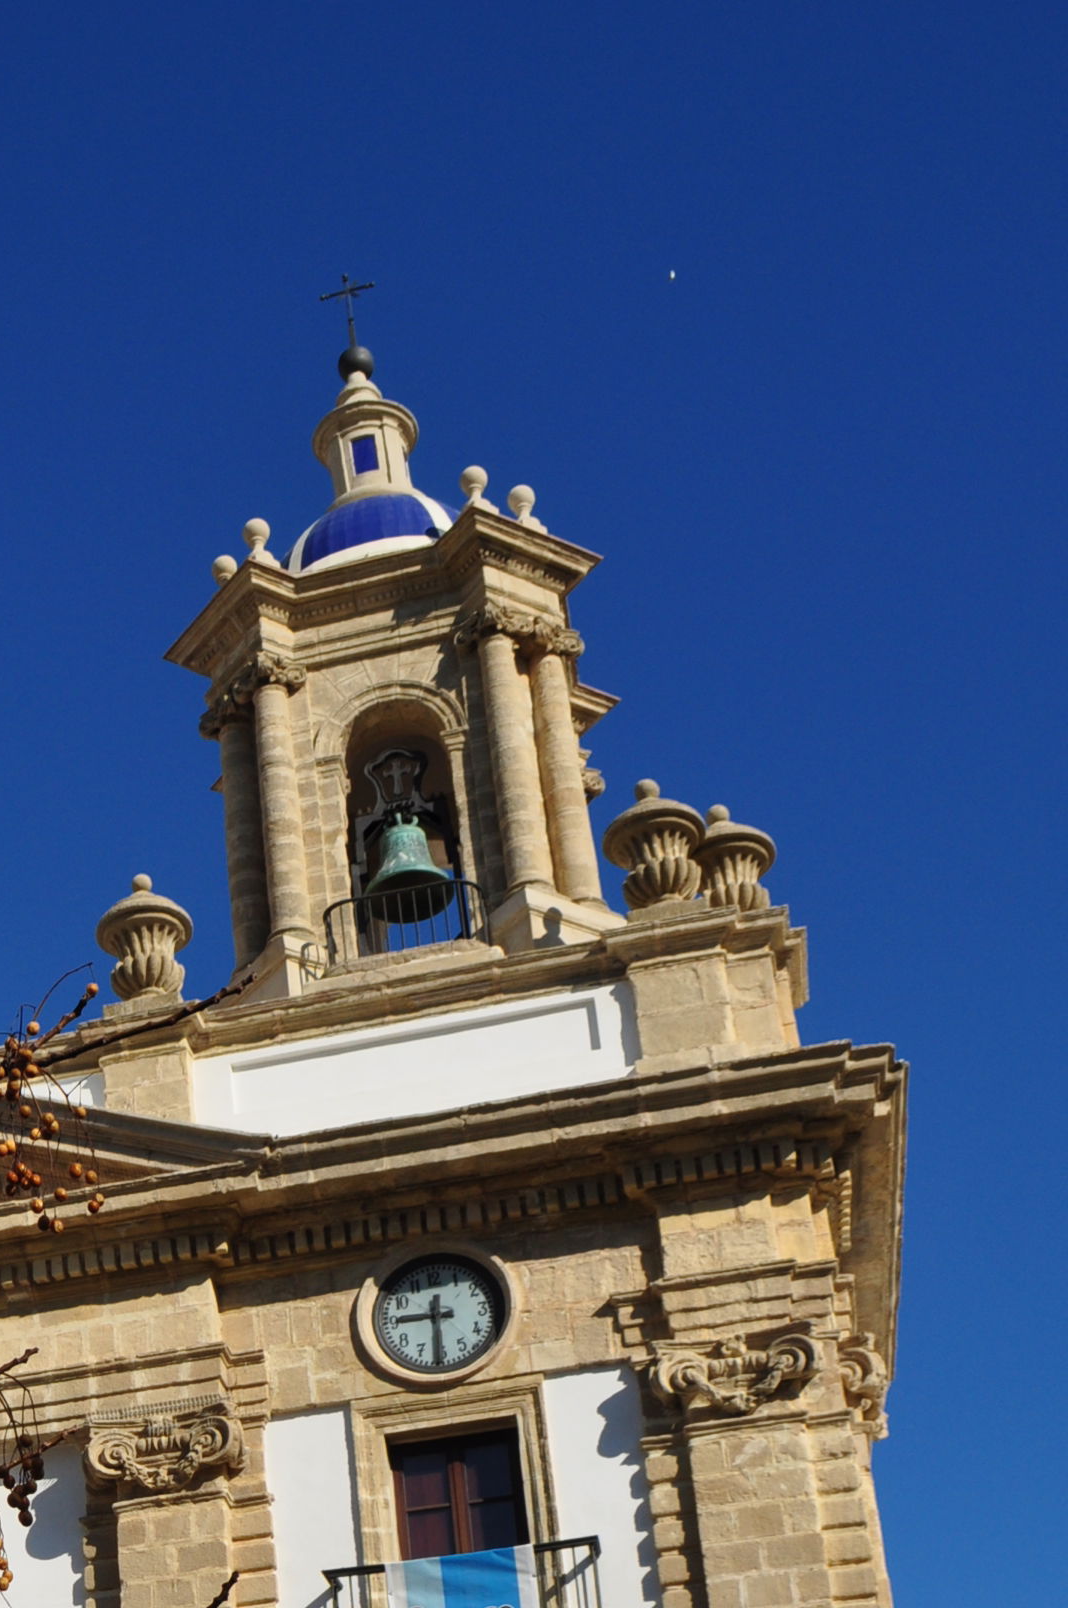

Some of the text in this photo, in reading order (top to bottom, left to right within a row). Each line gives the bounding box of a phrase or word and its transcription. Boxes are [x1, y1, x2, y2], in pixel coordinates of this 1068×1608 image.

[427, 1271, 441, 1286] 12
[410, 1279, 421, 1294] 11
[468, 1282, 479, 1297] 2
[395, 1294, 409, 1310] 10
[477, 1301, 488, 1317] 3
[389, 1315, 399, 1330] 9
[472, 1321, 482, 1336] 4
[399, 1333, 409, 1348] 8
[457, 1337, 467, 1352] 5
[416, 1342, 426, 1357] 7
